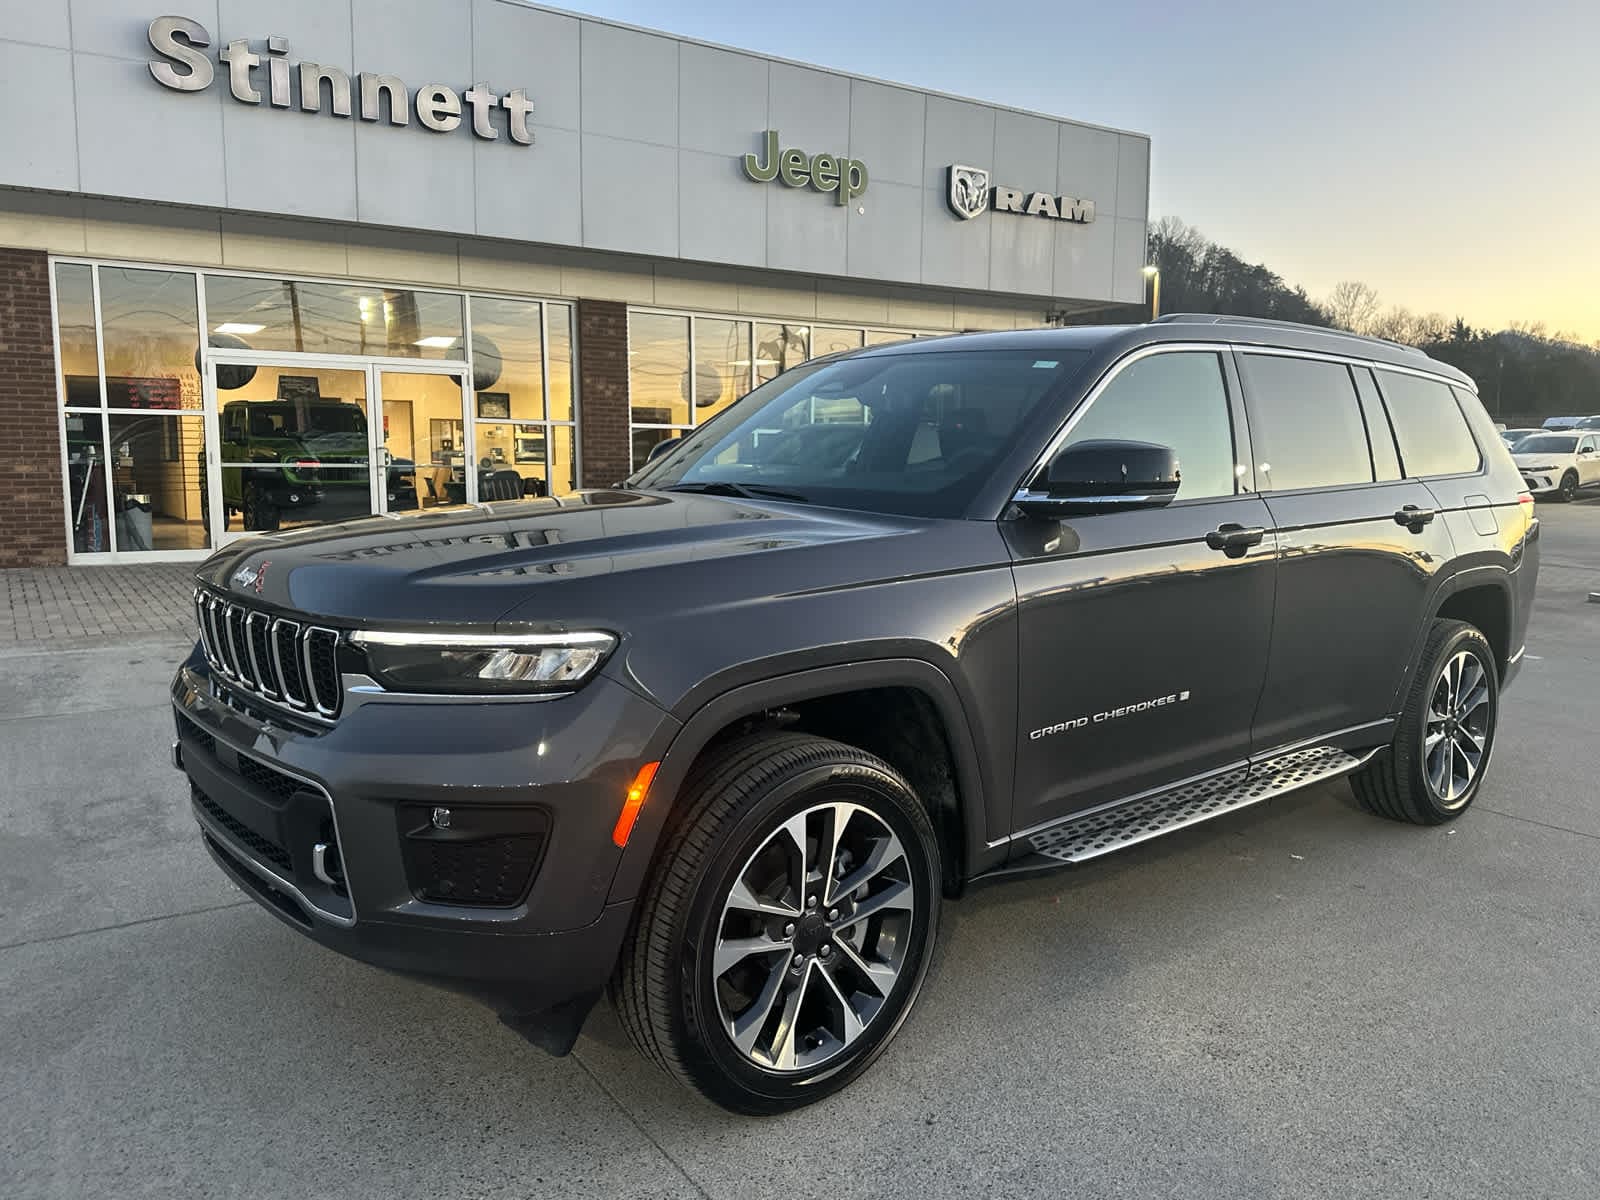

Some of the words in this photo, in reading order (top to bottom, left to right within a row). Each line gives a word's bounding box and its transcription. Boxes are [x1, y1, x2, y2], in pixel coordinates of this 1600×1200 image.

[148, 15, 535, 146] Stinnett
[744, 129, 868, 206] Jeep
[991, 184, 1096, 223] RAM
[1029, 717, 1089, 740] GRAND
[1092, 694, 1177, 723] CHEROKEE
